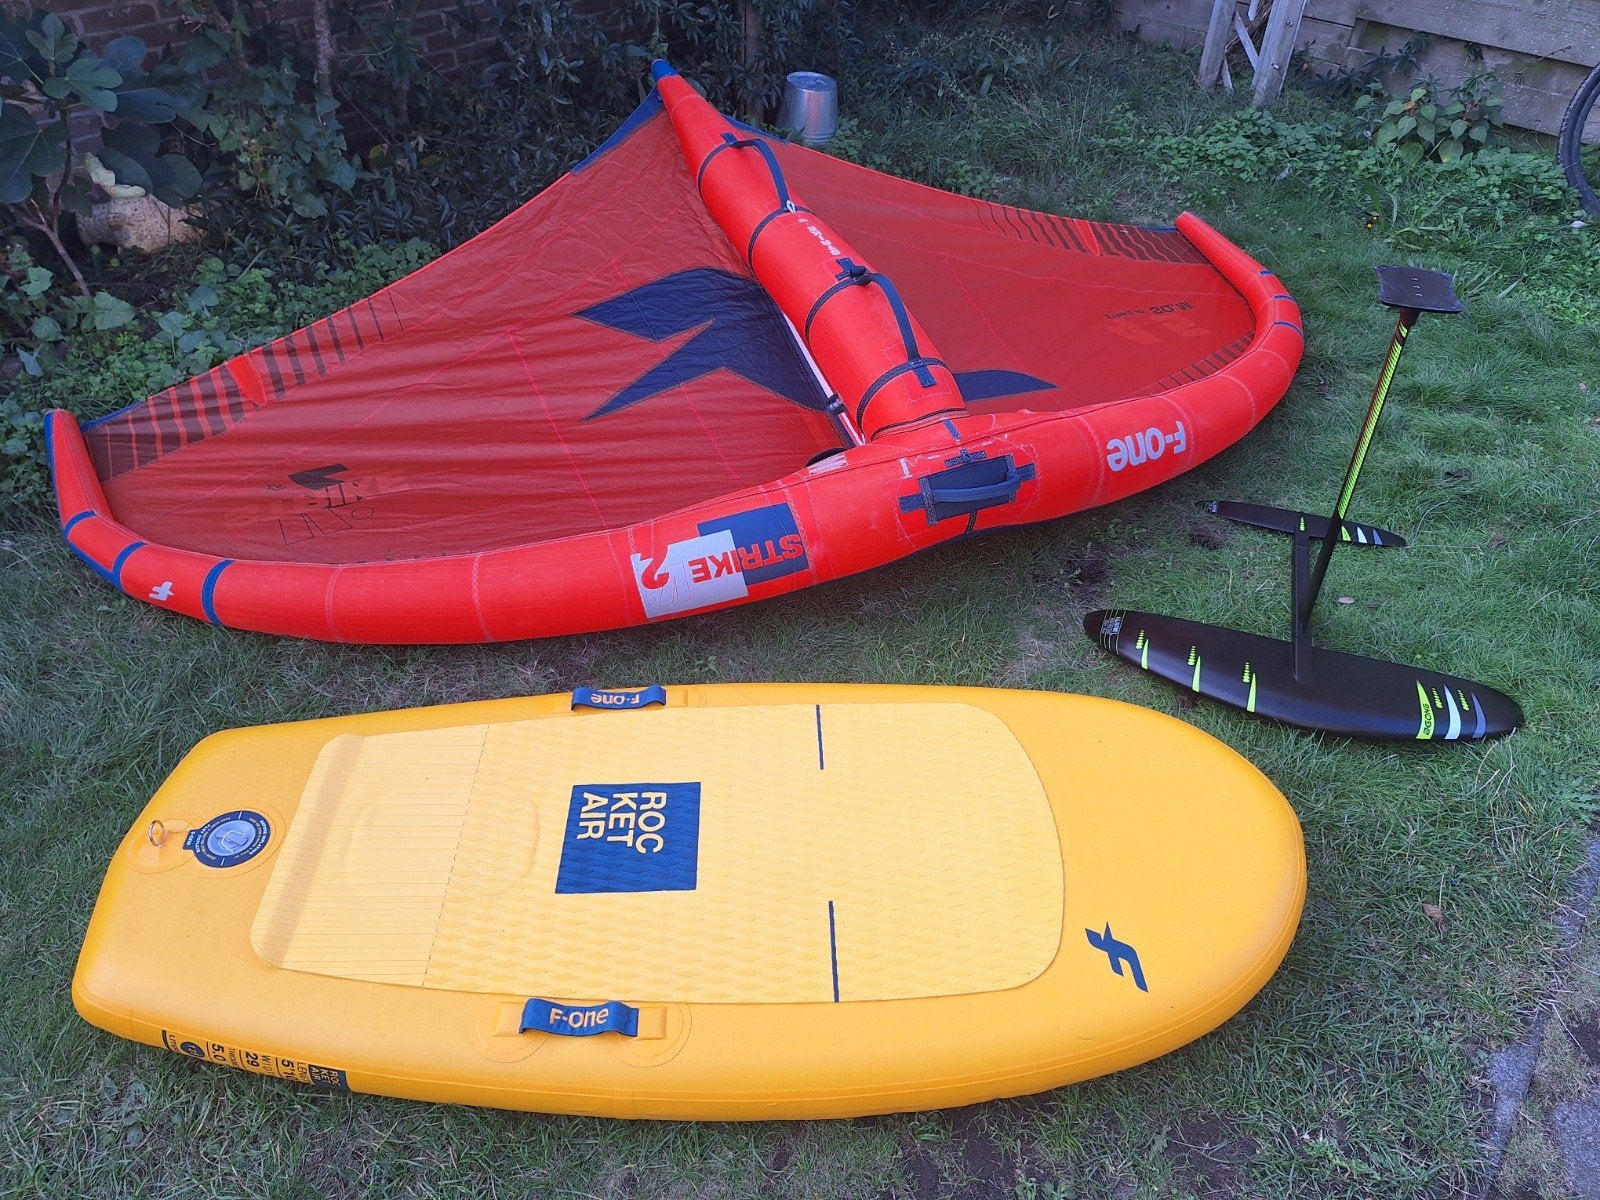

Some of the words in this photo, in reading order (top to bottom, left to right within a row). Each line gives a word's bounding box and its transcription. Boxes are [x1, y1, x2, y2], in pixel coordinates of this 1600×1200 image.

[688, 534, 804, 584] STRIKE
[576, 791, 609, 840] AIR
[606, 792, 638, 848] KET
[635, 791, 667, 854] ROC
[211, 1043, 226, 1062] 5.0
[245, 1051, 260, 1067] 29
[310, 1066, 321, 1081] AIR
[320, 1069, 331, 1084] KET
[329, 1071, 341, 1087] ROC
